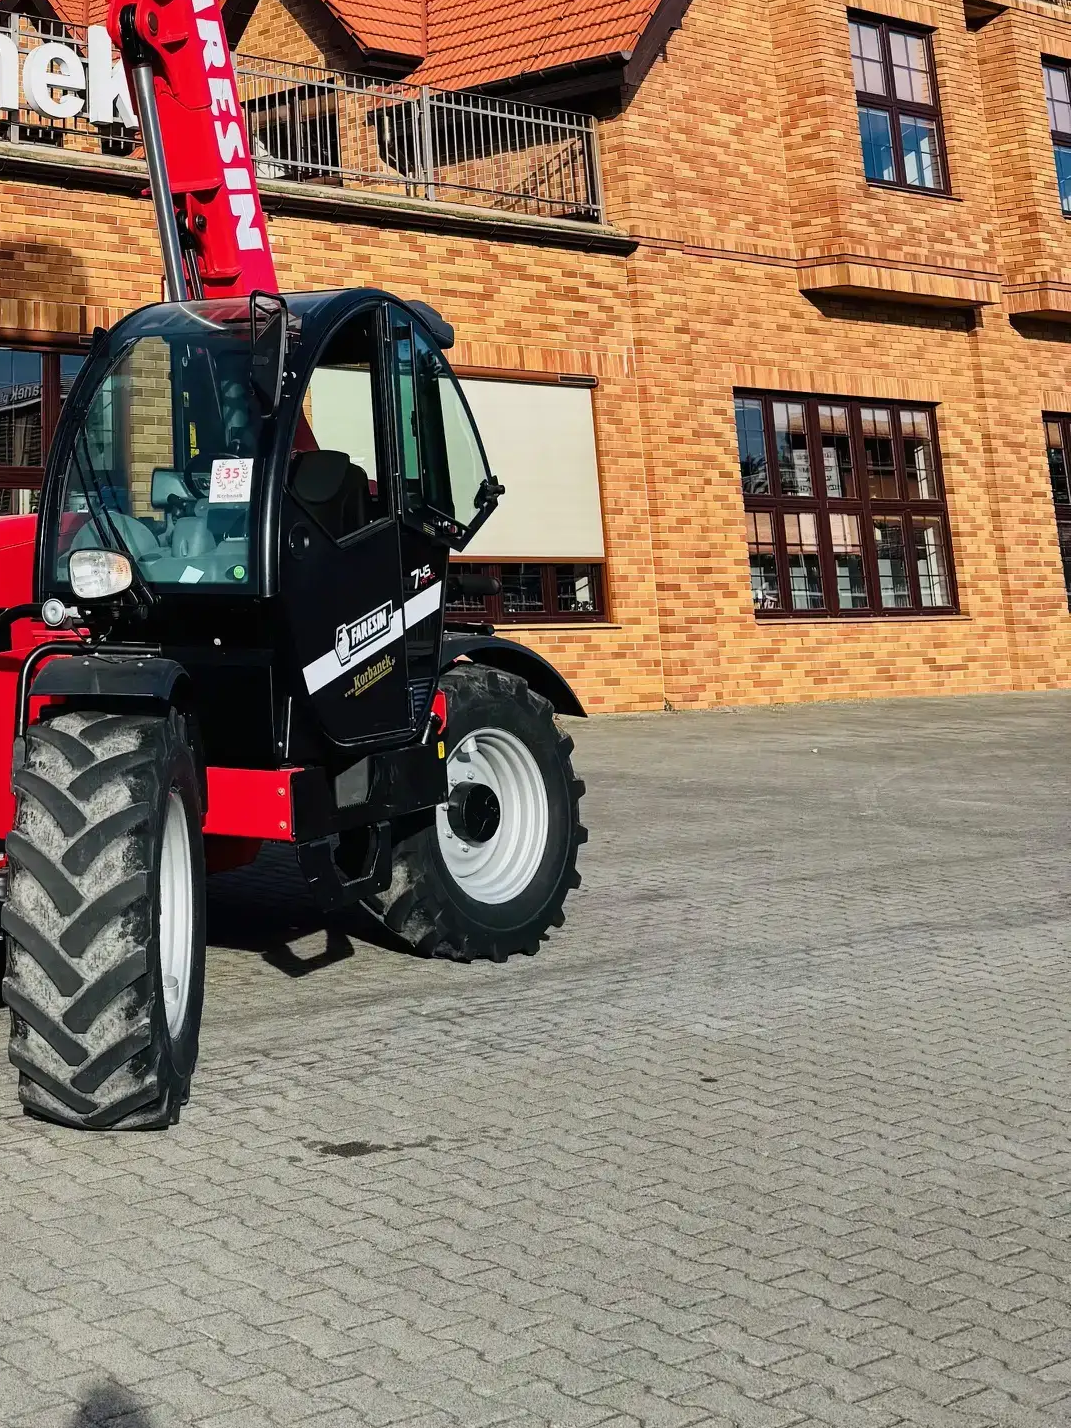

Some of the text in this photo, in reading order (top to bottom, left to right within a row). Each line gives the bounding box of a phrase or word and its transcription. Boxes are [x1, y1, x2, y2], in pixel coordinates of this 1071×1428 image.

[223, 467, 240, 479] 35
[410, 563, 431, 590] 745
[351, 608, 387, 647] FARESIN
